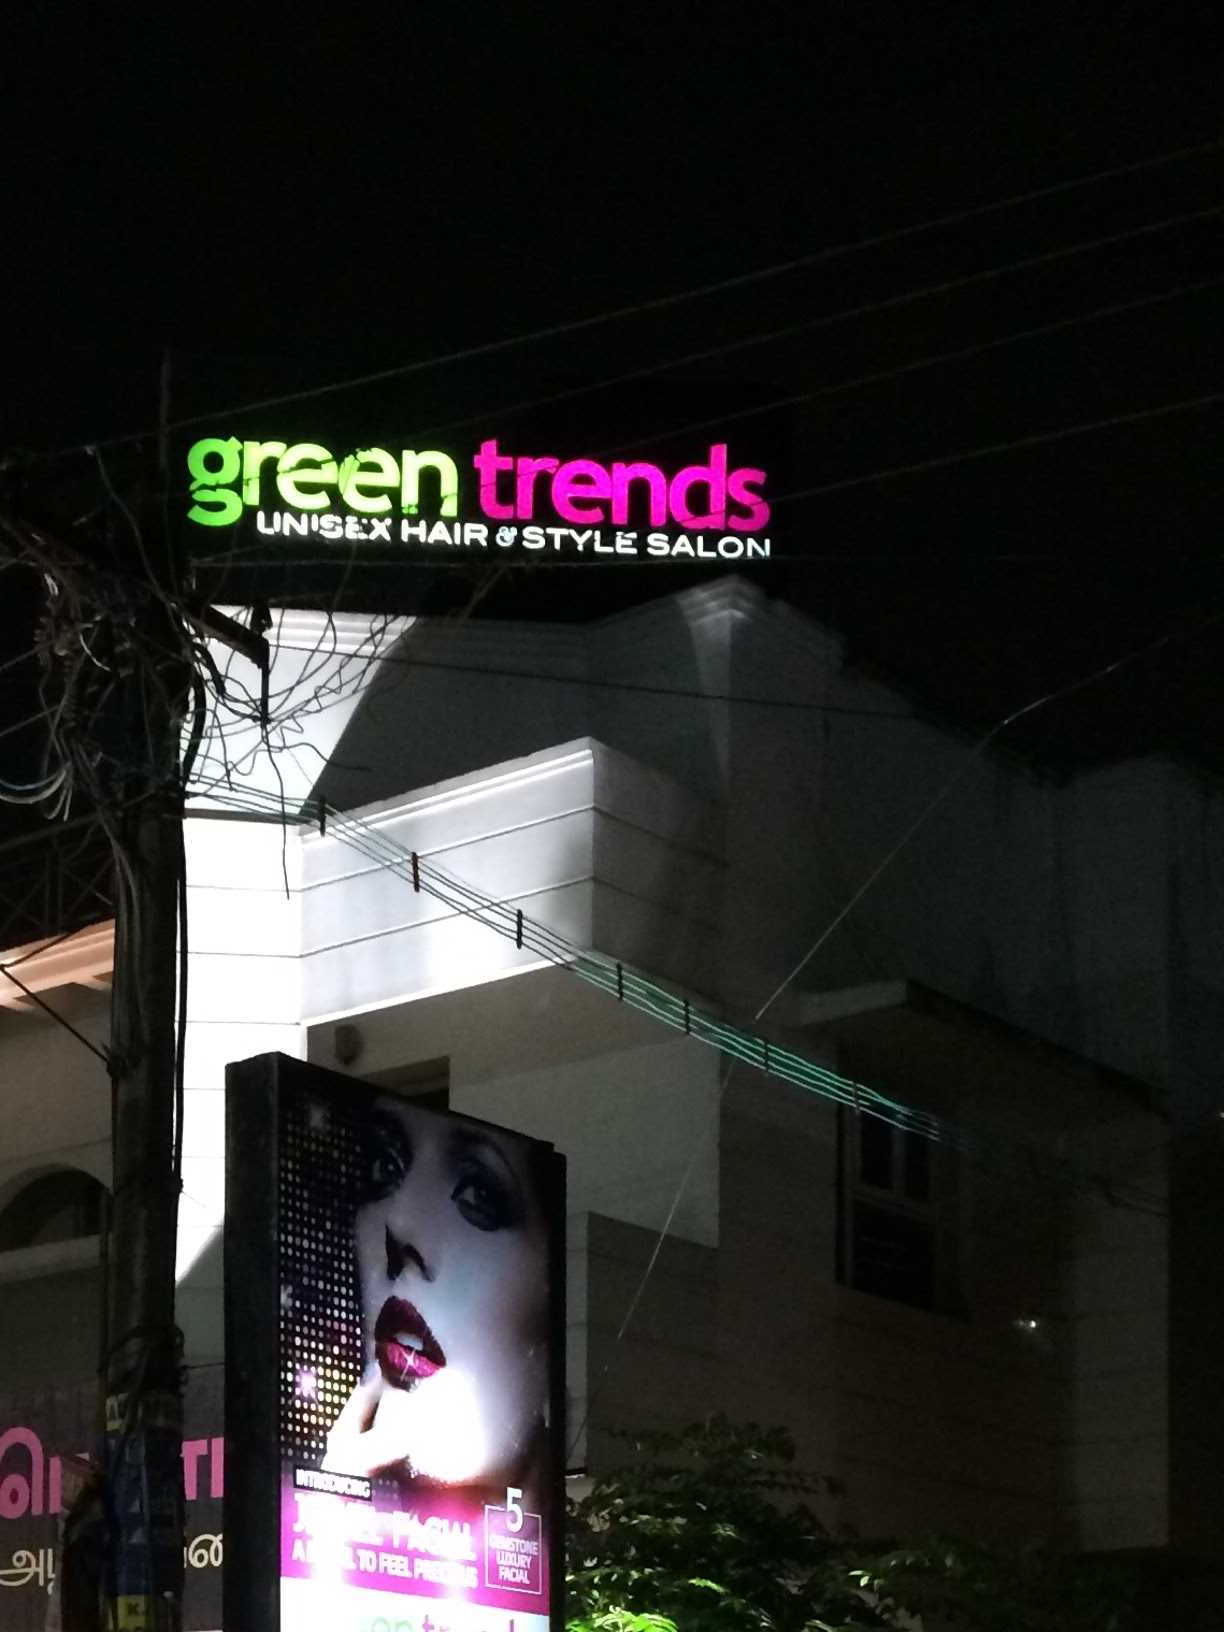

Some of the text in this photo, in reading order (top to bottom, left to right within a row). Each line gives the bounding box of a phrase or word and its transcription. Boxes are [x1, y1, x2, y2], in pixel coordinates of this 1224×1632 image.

[187, 435, 771, 532] green trends
[256, 511, 391, 542] UNISEX
[401, 523, 487, 547] HAIR
[522, 527, 638, 555] STYLE
[647, 533, 771, 558] SALON
[505, 1487, 524, 1533] 5
